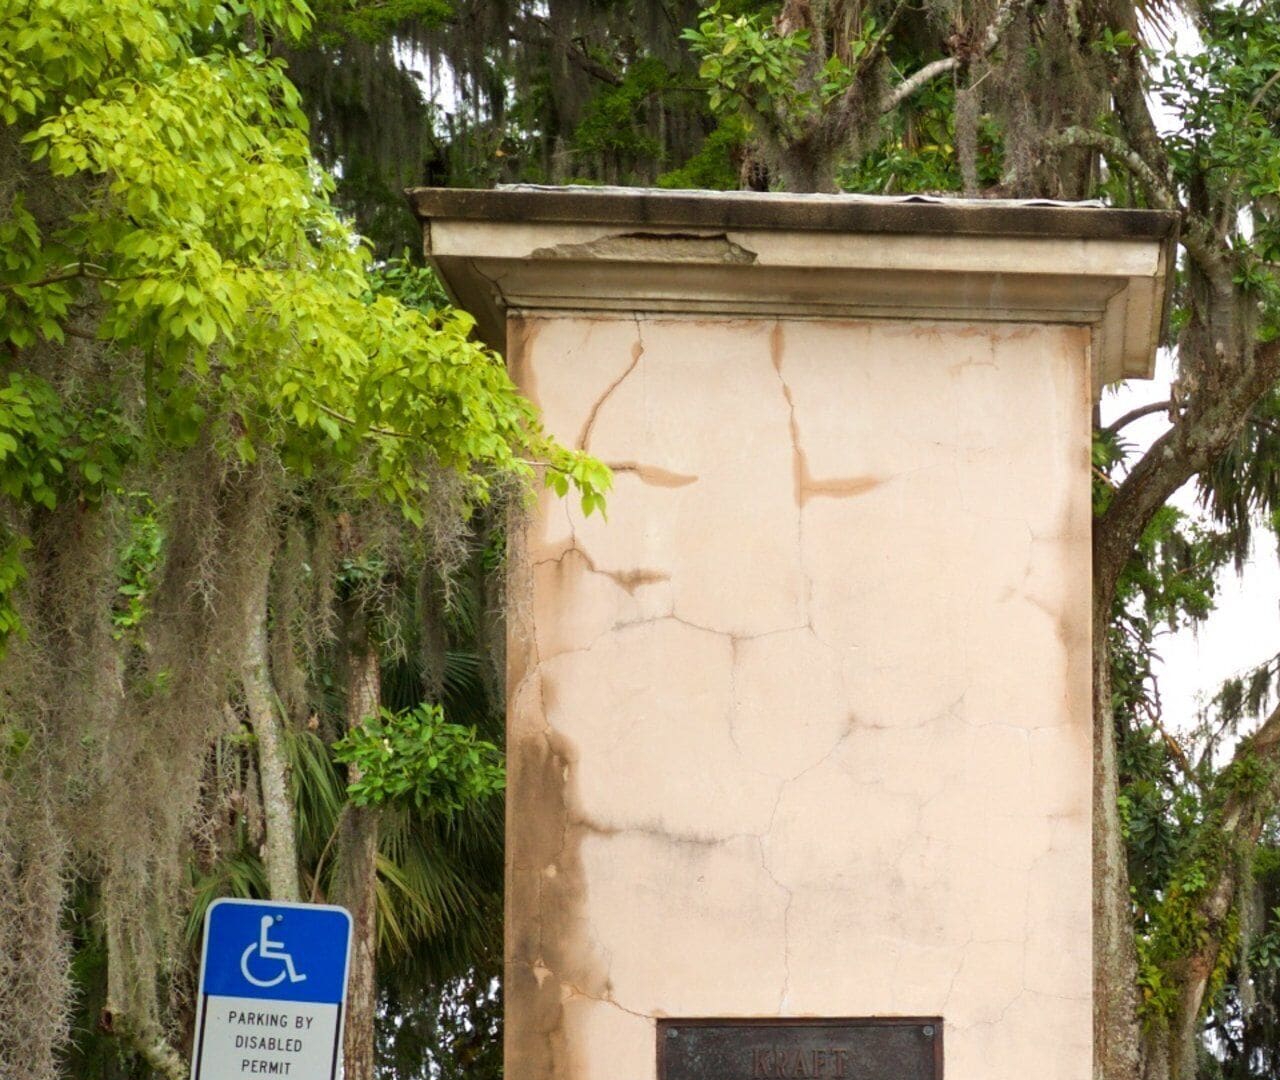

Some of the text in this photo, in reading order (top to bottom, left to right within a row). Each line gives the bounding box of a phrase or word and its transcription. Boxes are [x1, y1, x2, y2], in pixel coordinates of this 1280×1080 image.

[228, 1011, 313, 1029] PARKING BY
[235, 1035, 302, 1052] DISABLED
[241, 1059, 291, 1074] PERMIT
[753, 1048, 849, 1080] KRAFT
